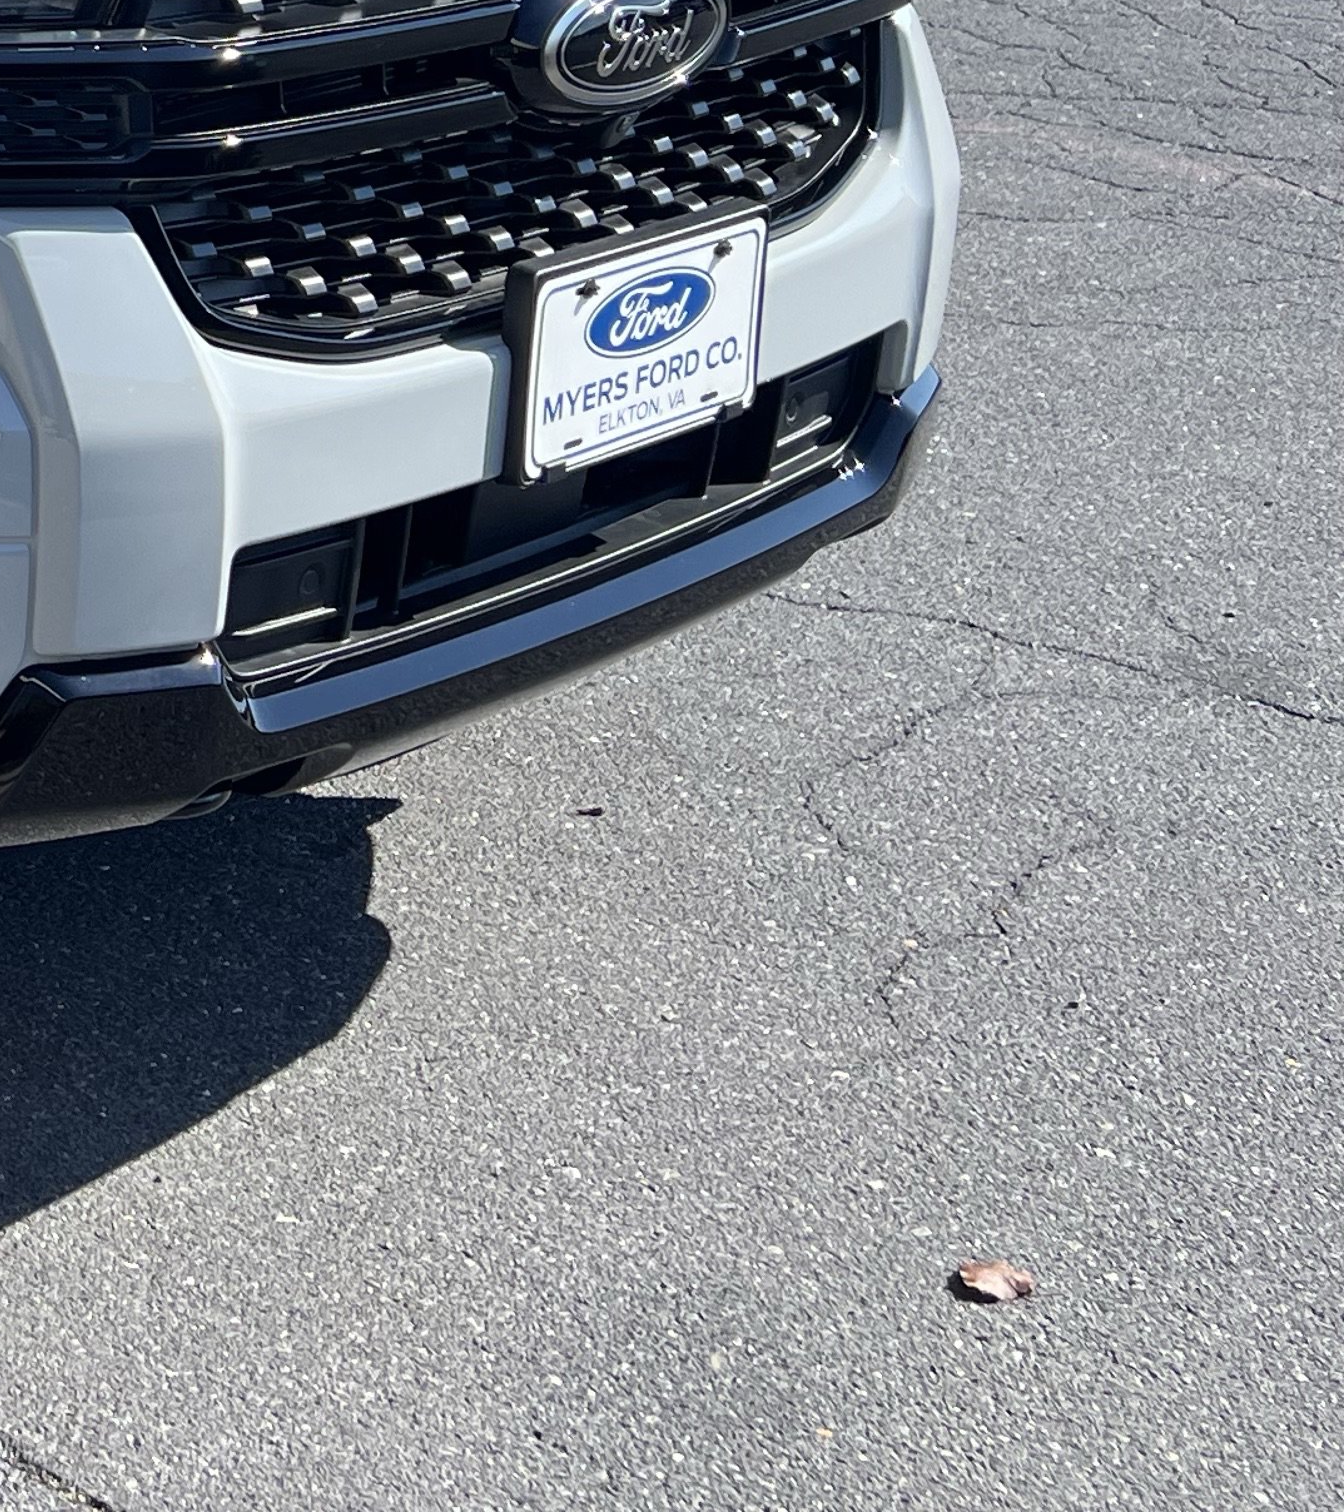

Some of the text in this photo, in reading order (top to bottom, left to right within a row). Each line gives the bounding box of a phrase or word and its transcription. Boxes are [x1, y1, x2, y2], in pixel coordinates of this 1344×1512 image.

[596, 0, 694, 78] Ford
[609, 281, 692, 347] Ford
[542, 336, 742, 426] MYERS FORD CO.
[598, 389, 687, 434] ELKTON, VA
